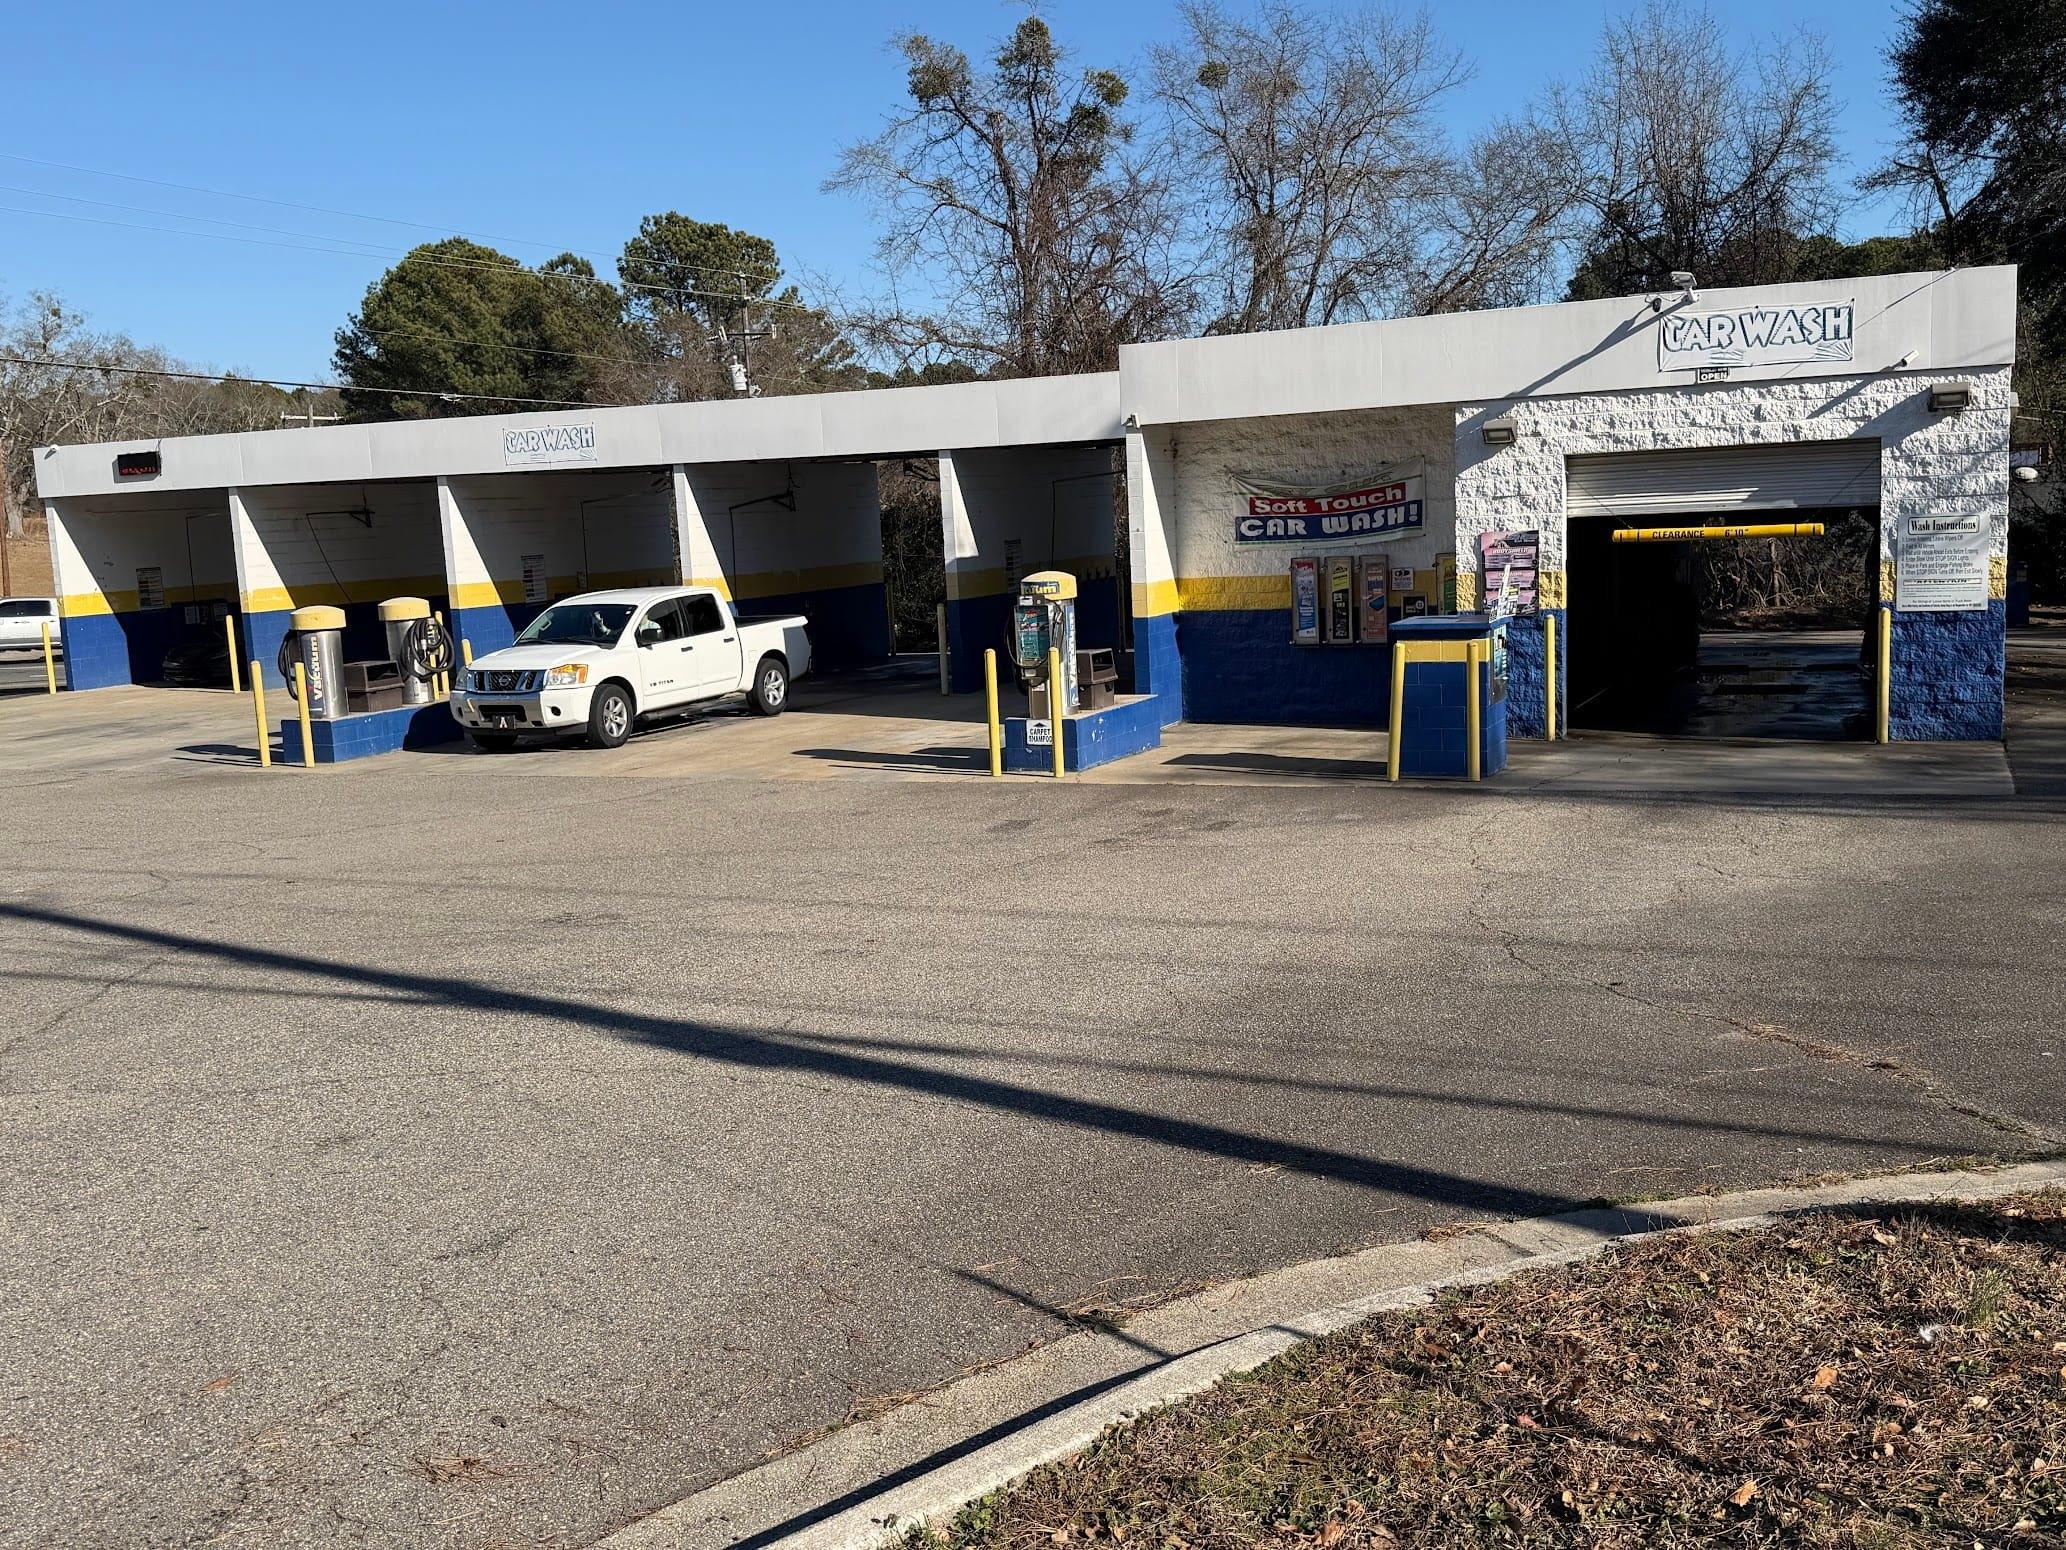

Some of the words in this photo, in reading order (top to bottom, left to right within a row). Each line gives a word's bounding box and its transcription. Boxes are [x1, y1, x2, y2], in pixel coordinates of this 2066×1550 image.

[1663, 314, 1735, 352] CAR
[1739, 306, 1851, 347] WASH
[1700, 372, 1727, 381] OPEN
[506, 431, 540, 453] CAR
[540, 427, 594, 451] WASH
[1254, 500, 1307, 514] Soft
[1315, 487, 1401, 511] Touch
[1239, 519, 1307, 537] CAR
[1321, 503, 1418, 533] WASH!
[1911, 520, 1930, 531] Wash
[1932, 518, 1976, 531] Instructions
[1652, 530, 1705, 539] CLEARANCE
[499, 717, 508, 728] A
[1029, 728, 1051, 736] CARPET
